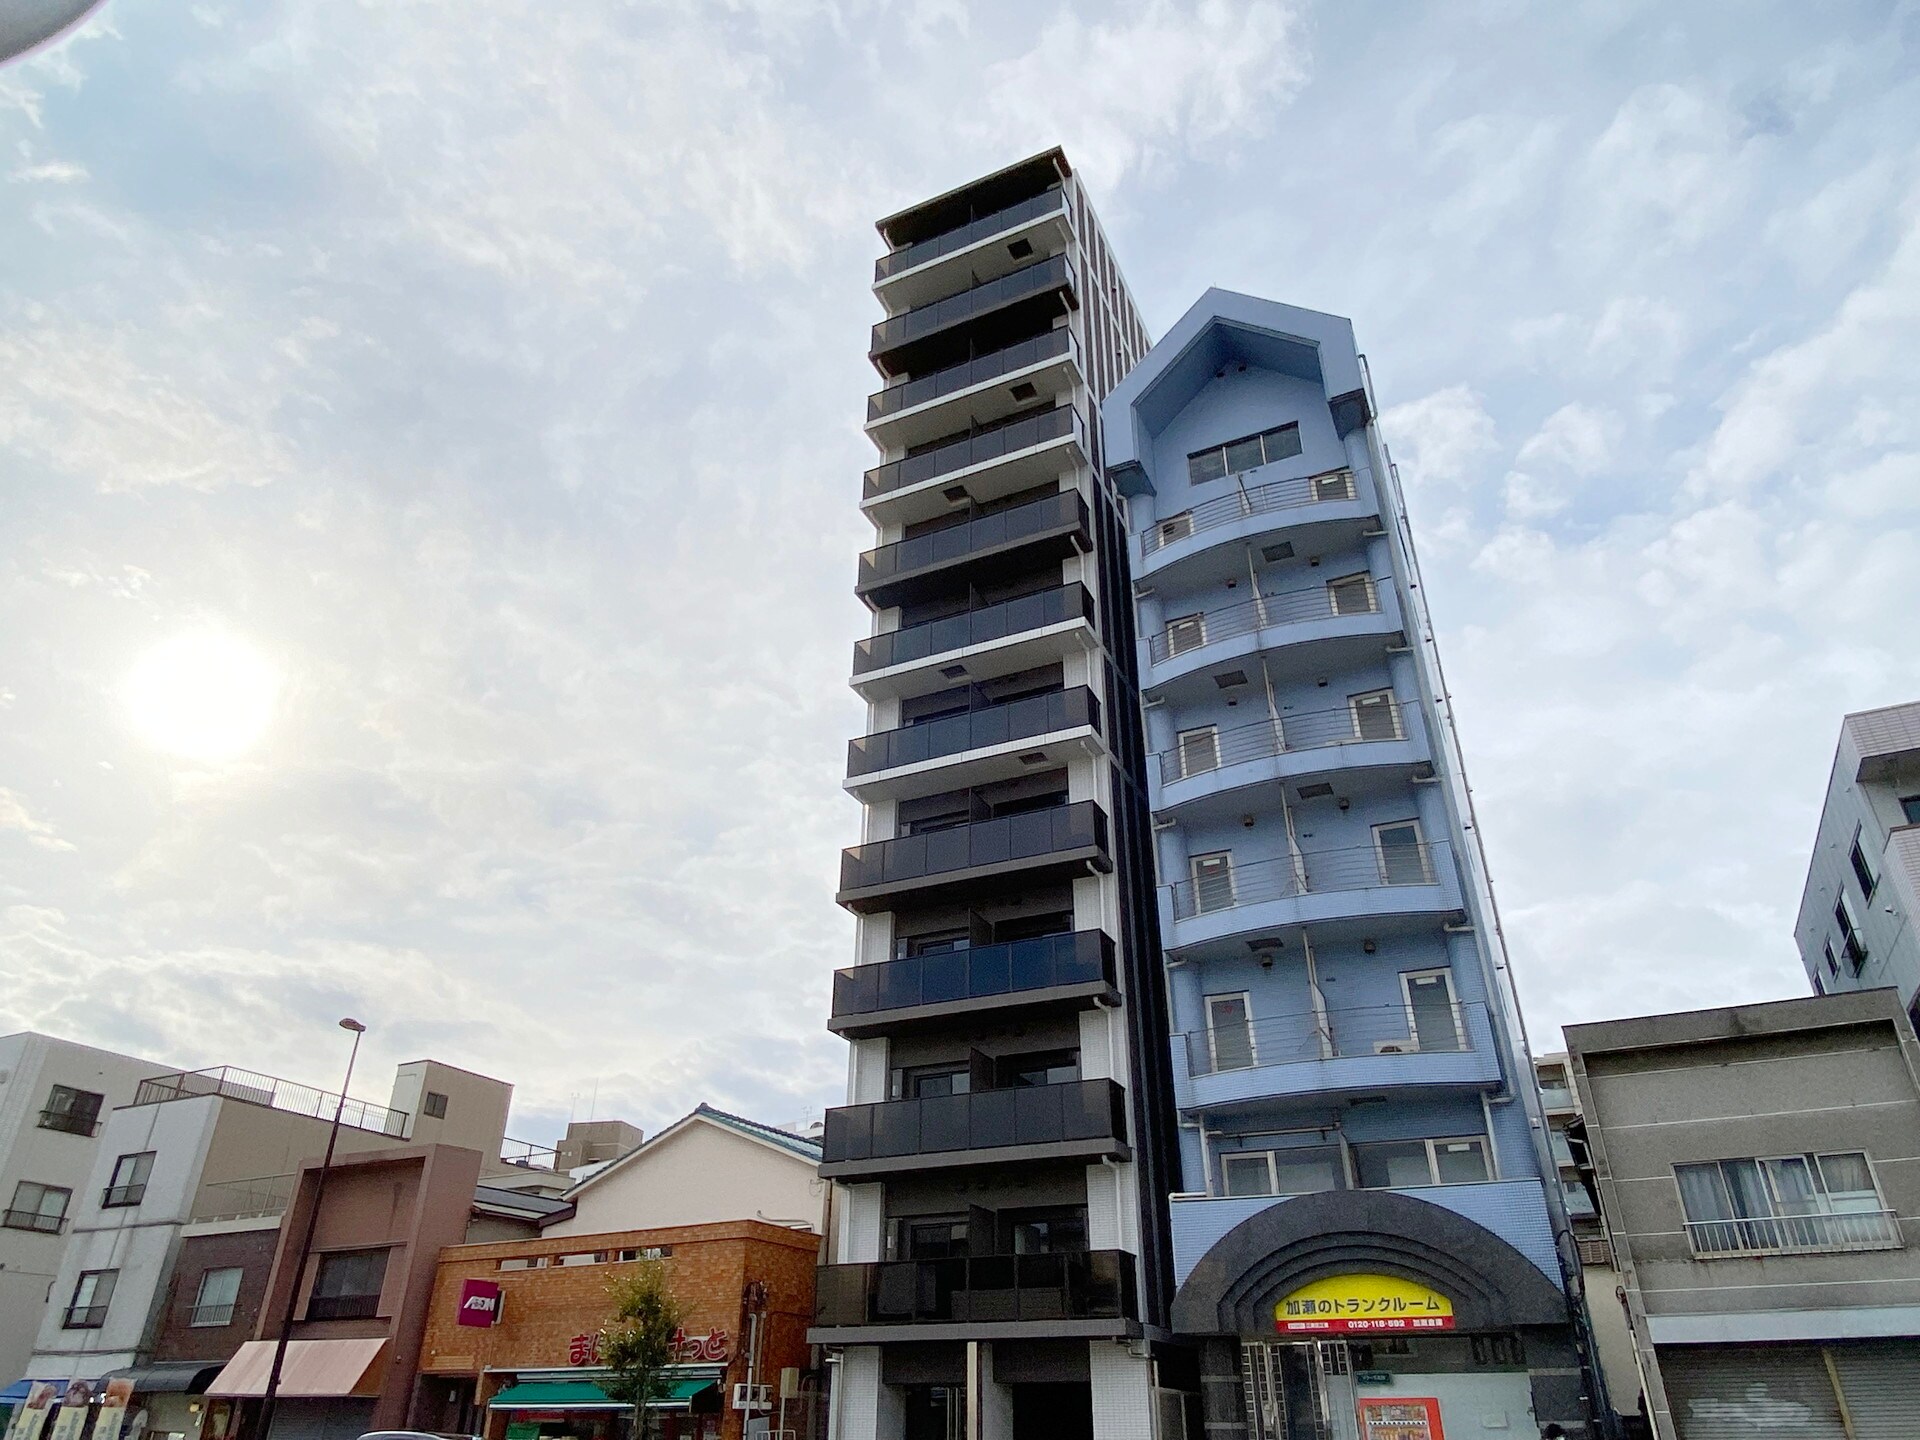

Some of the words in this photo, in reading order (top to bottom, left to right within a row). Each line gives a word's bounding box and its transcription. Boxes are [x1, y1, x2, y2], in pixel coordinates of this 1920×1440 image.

[463, 1296, 496, 1312] AEON
[1286, 1296, 1440, 1316] 加瀬のトランクルーム
